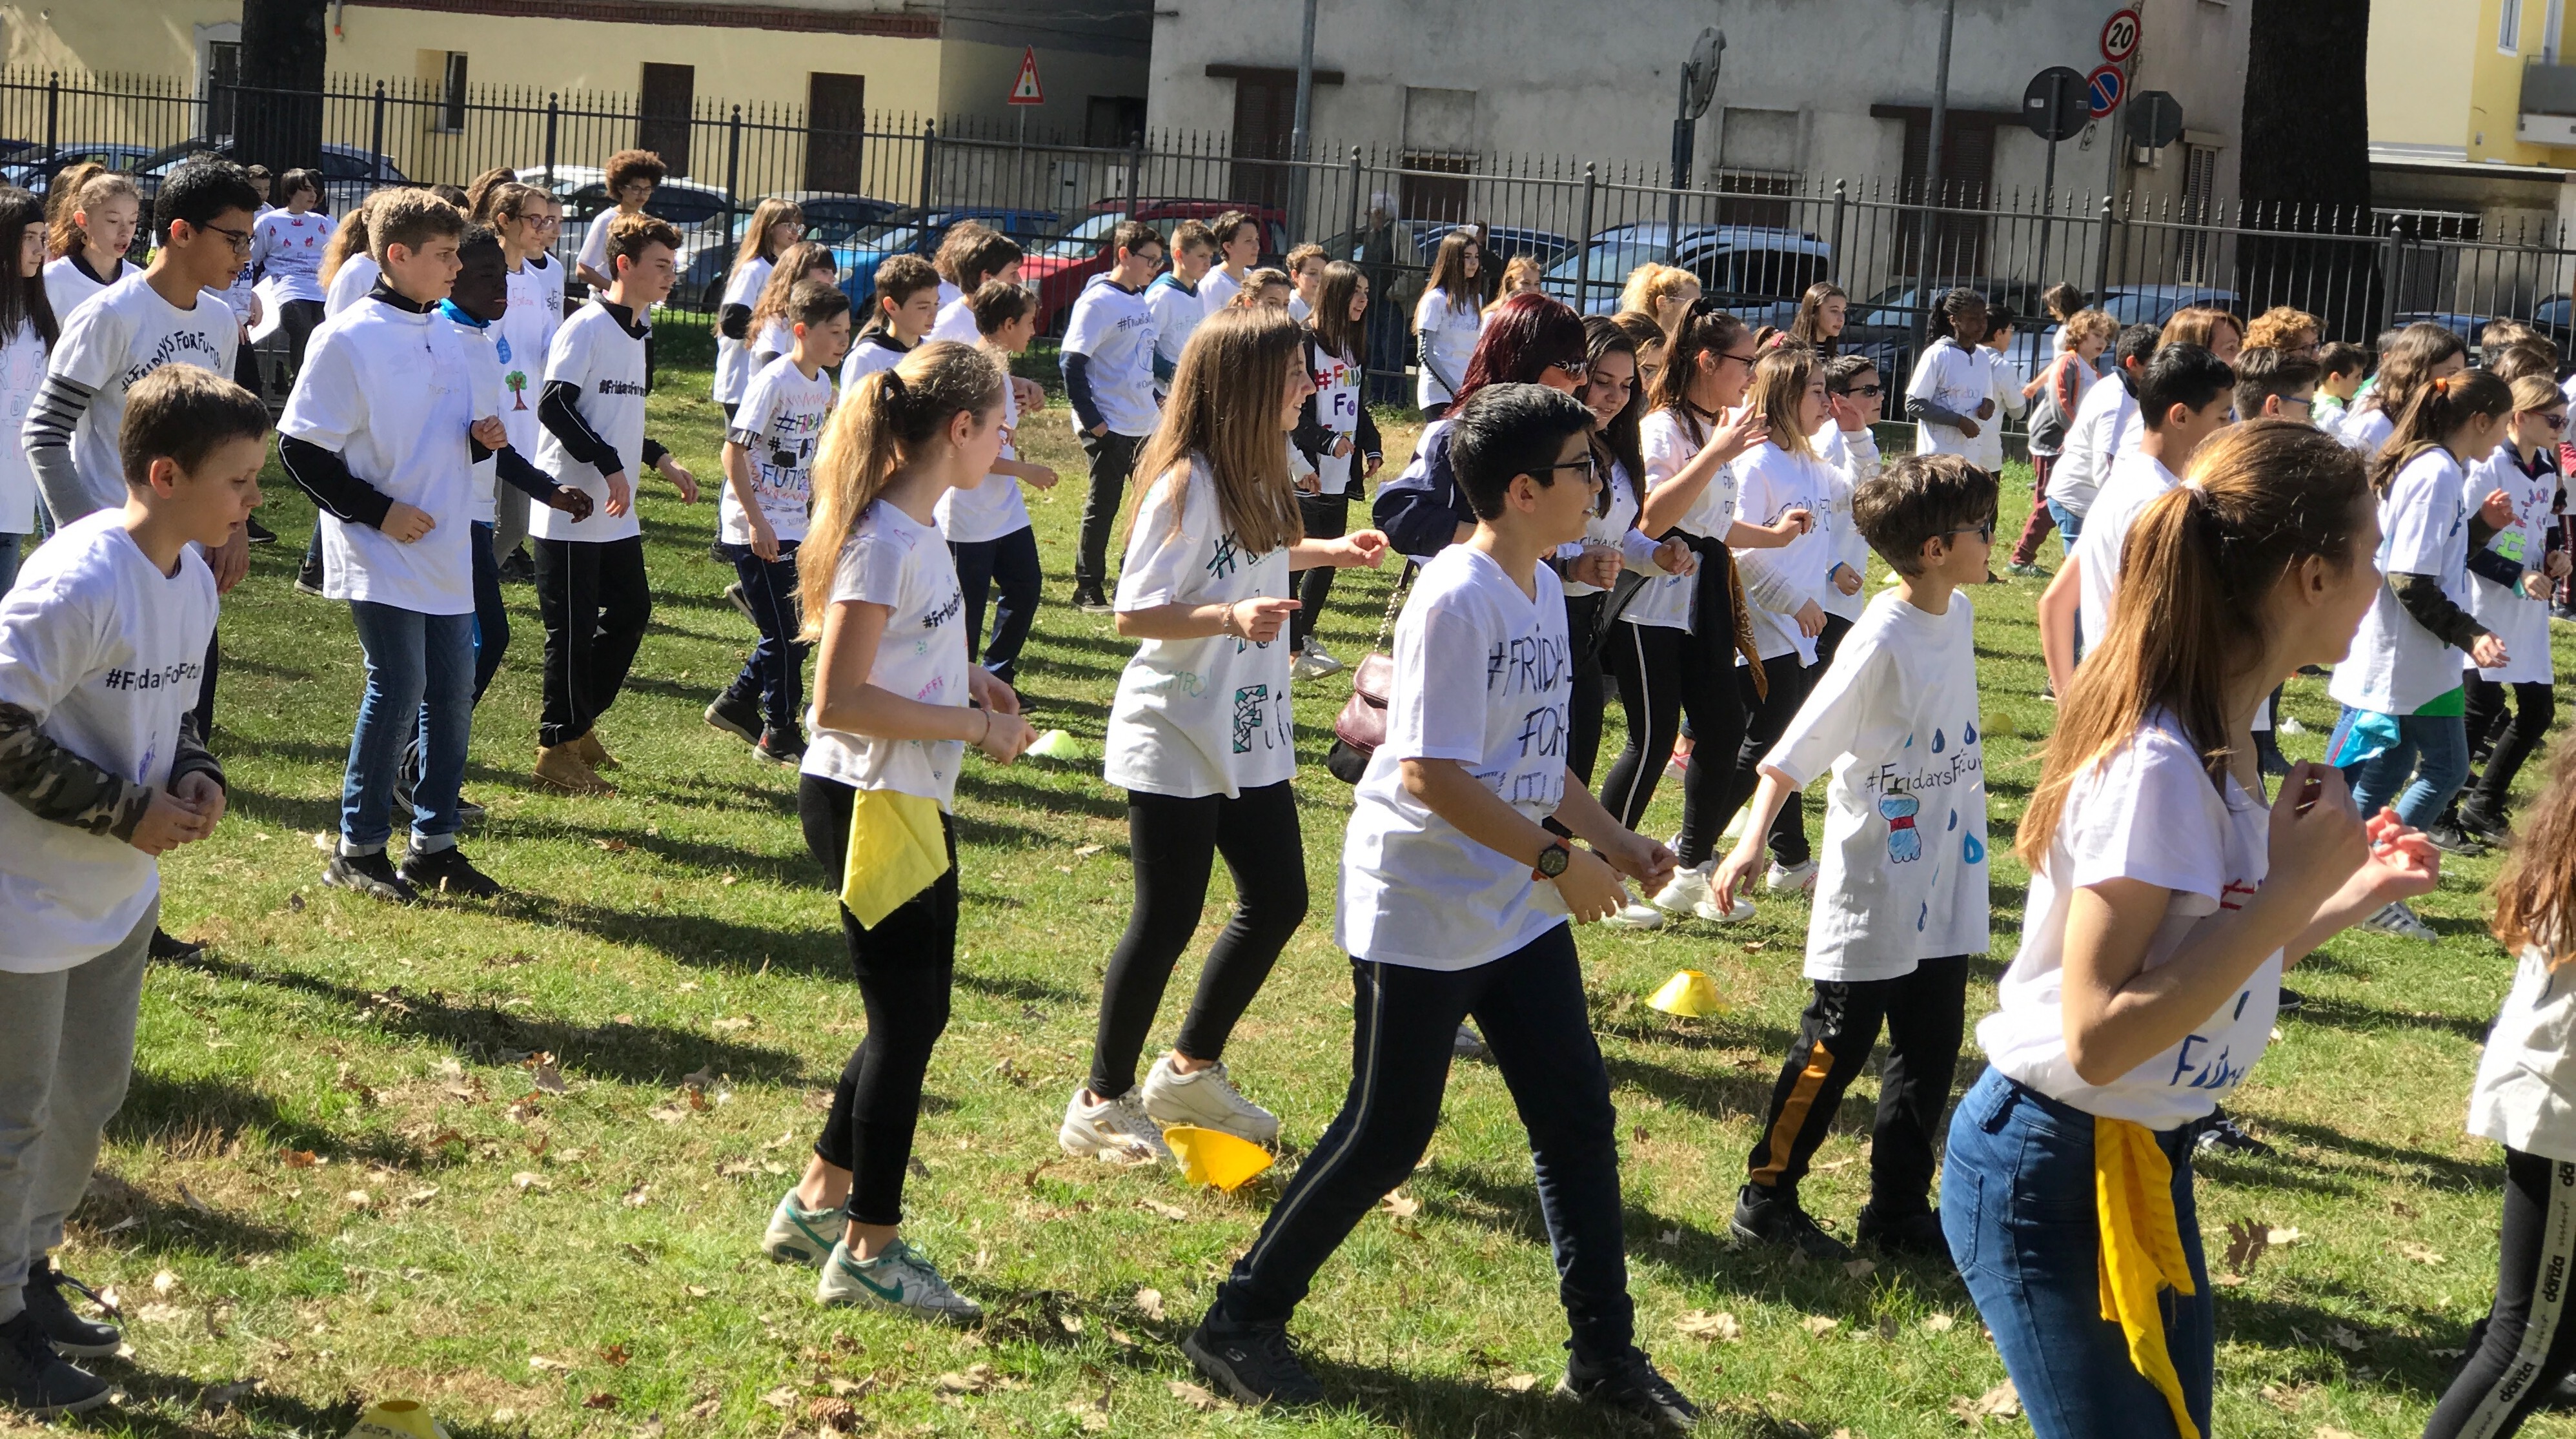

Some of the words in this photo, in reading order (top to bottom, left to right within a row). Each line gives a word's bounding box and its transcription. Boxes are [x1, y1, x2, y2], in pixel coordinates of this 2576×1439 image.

[2109, 22, 2134, 49] 20
[2542, 1254, 2565, 1303] danza
[2499, 1361, 2535, 1403] danza
